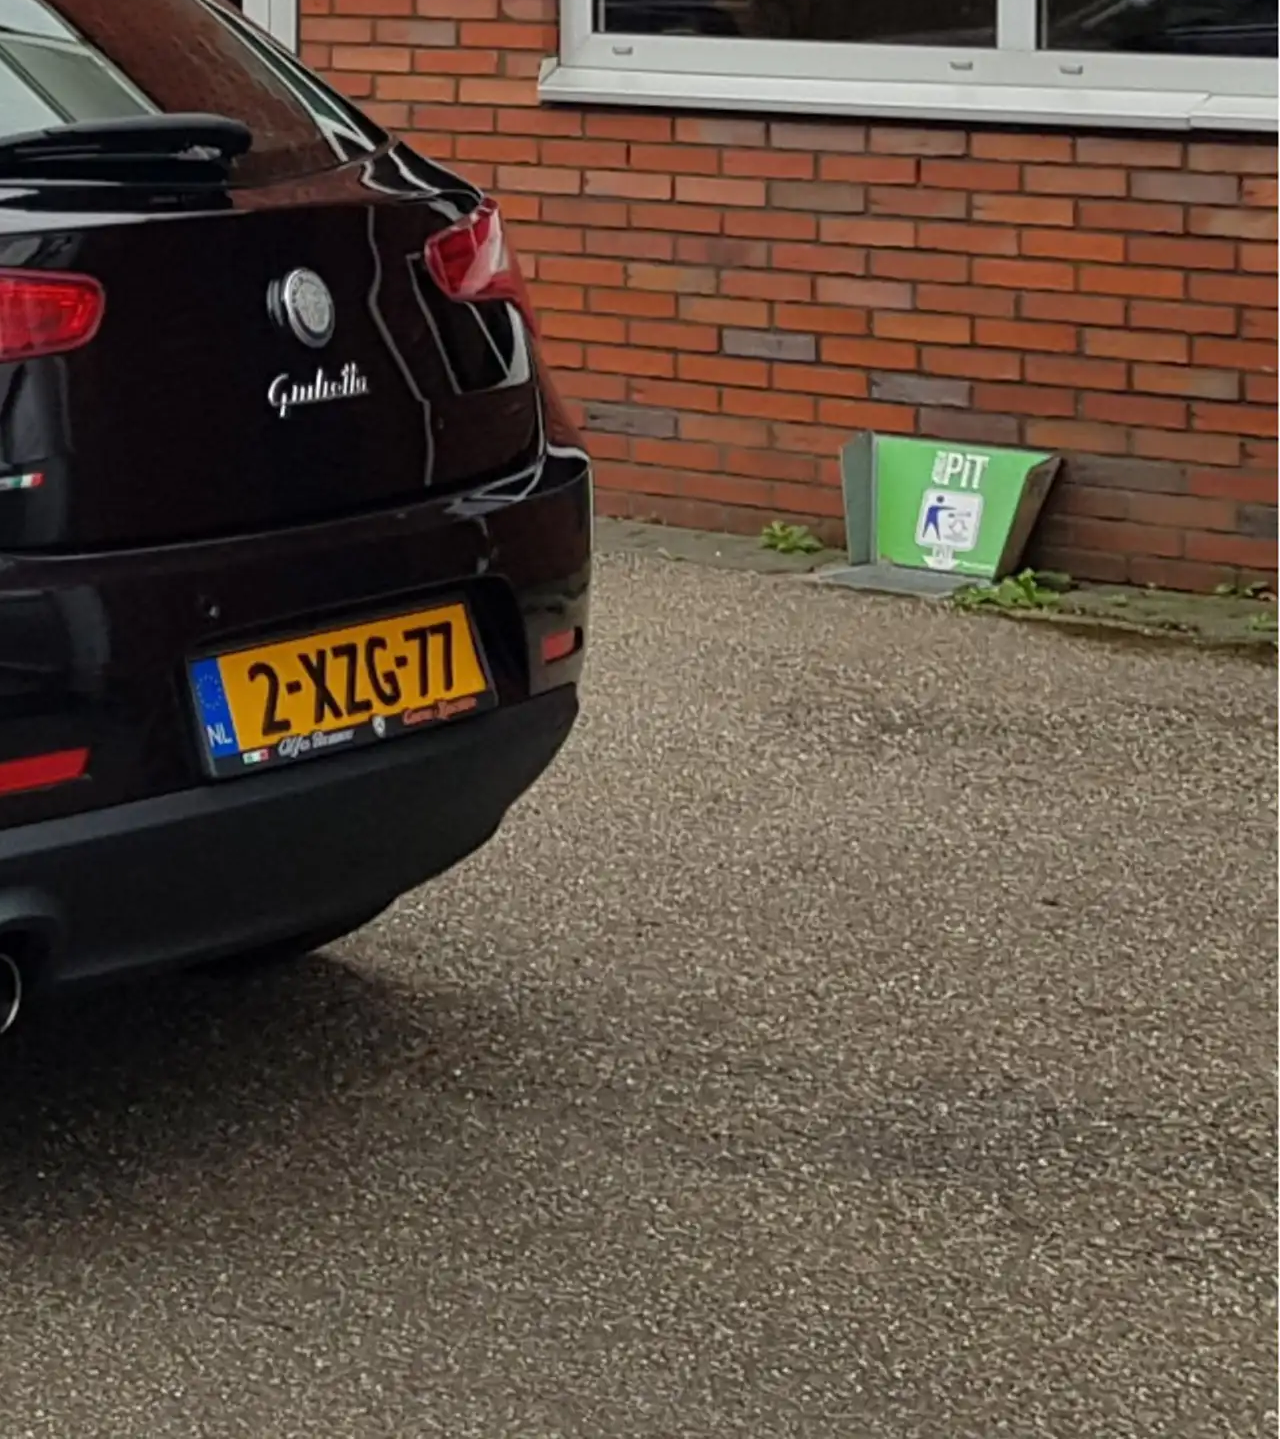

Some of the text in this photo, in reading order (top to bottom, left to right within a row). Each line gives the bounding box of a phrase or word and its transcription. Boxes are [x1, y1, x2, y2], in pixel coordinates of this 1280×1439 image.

[267, 361, 370, 419] Giulietta
[247, 620, 454, 737] 2-XZG-77
[206, 723, 234, 748] NL
